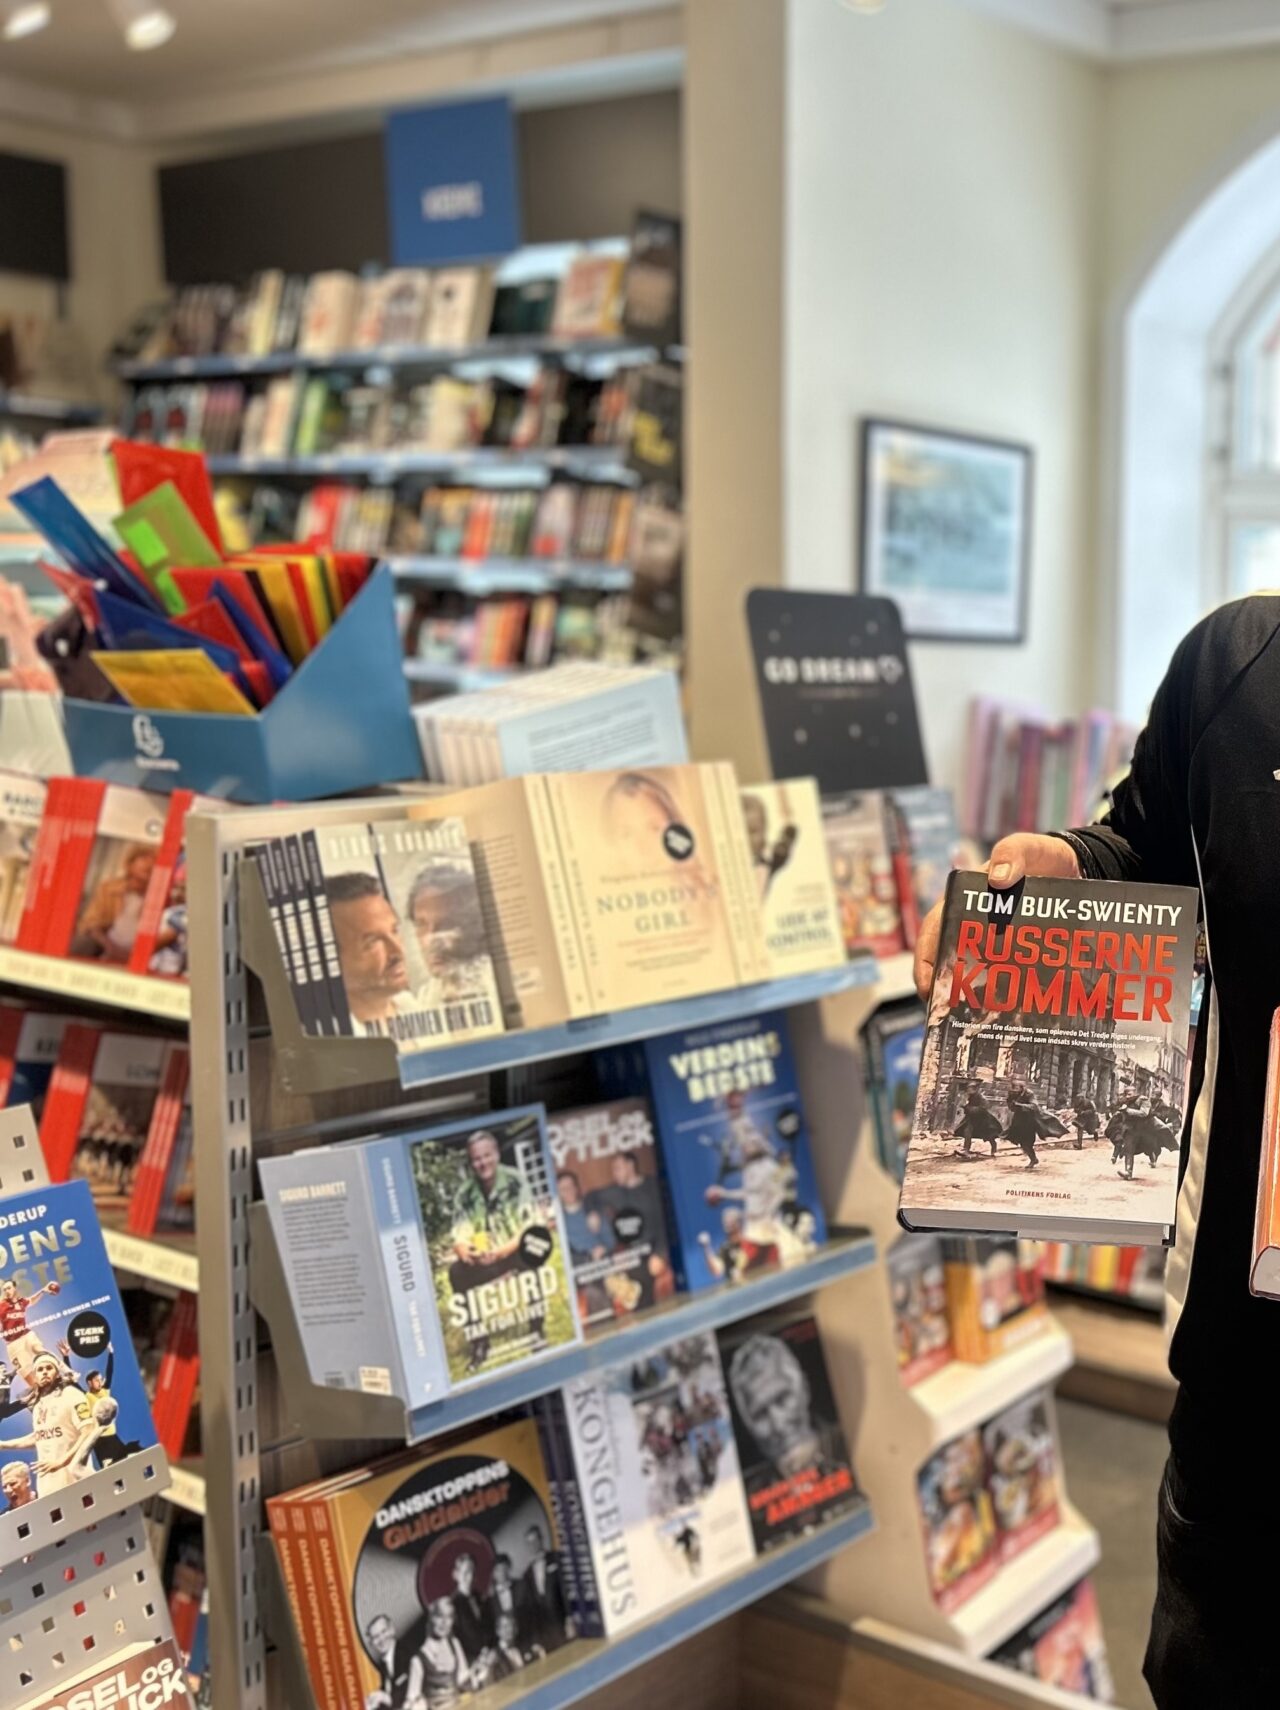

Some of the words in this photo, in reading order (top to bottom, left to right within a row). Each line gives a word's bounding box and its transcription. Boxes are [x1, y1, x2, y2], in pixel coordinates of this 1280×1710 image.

[963, 890, 1014, 915] TOM
[1021, 896, 1182, 926] BUK-SWIENTY
[957, 920, 1178, 974] RUSSERNE
[948, 958, 1173, 1023] KOMMER
[977, 1032, 994, 1040] mens
[995, 1032, 1003, 1040] de
[1004, 1032, 1018, 1041] med
[1019, 1033, 1033, 1042] livet
[1034, 1036, 1047, 1044] som
[1048, 1036, 1070, 1046] indsats
[993, 1023, 1004, 1031] fire
[1078, 1029, 1089, 1038] Det
[550, 1121, 655, 1168] YTLICK
[1005, 1189, 1044, 1198] POLITIKENS
[0, 1204, 47, 1230] DERUP
[393, 1235, 416, 1292] SIGURD
[448, 1265, 558, 1327] SIGURD
[73, 1325, 105, 1337] STÆRK
[79, 1335, 100, 1346] PRIS
[464, 1321, 489, 1342] TAK
[375, 1460, 510, 1530] DANSKTOPPENS
[572, 1385, 638, 1618] KONGEHUS
[318, 1537, 348, 1645] DANSKTOPPENS
[338, 1646, 361, 1710] GULDALD
[141, 1658, 174, 1684] OG
[316, 1646, 339, 1710] GULDALD
